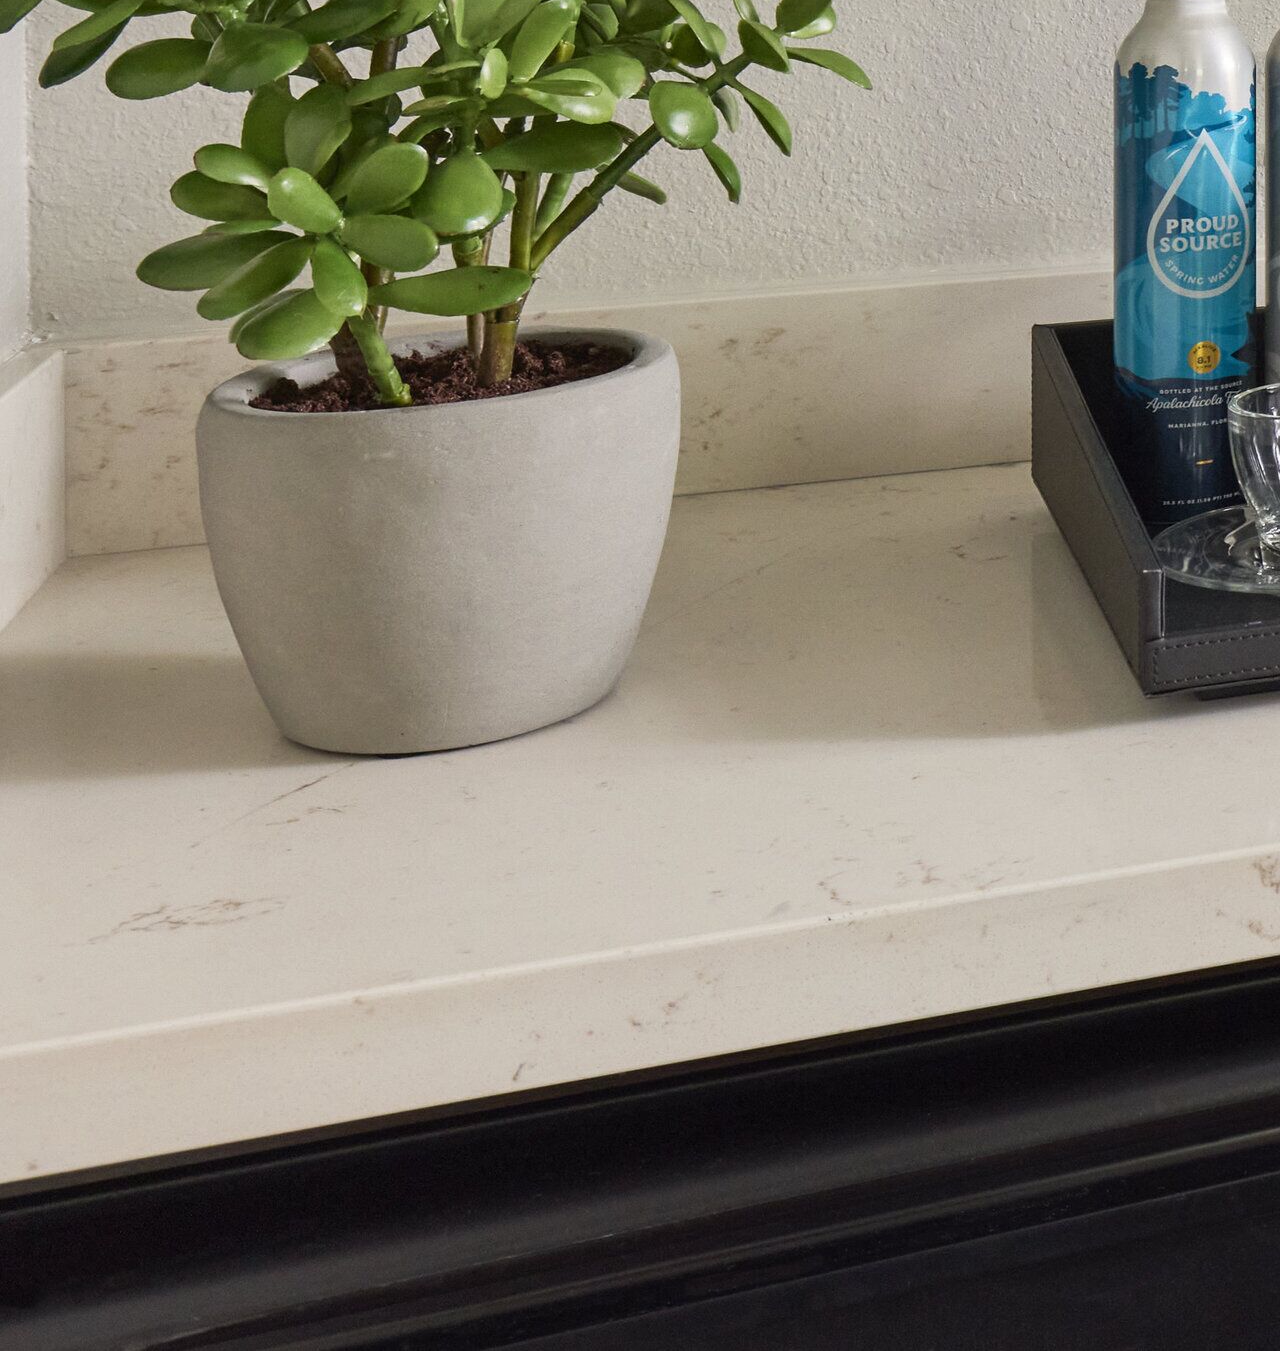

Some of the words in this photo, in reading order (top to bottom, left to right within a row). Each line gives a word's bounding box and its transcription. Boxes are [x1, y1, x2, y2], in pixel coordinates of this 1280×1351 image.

[1166, 214, 1239, 234] PROUD
[1159, 231, 1242, 253] SOURCE
[1164, 259, 1204, 285] SPRING
[1208, 254, 1239, 284] WATER
[1220, 380, 1243, 389] SOURCE
[1145, 393, 1223, 413] Apalachicola
